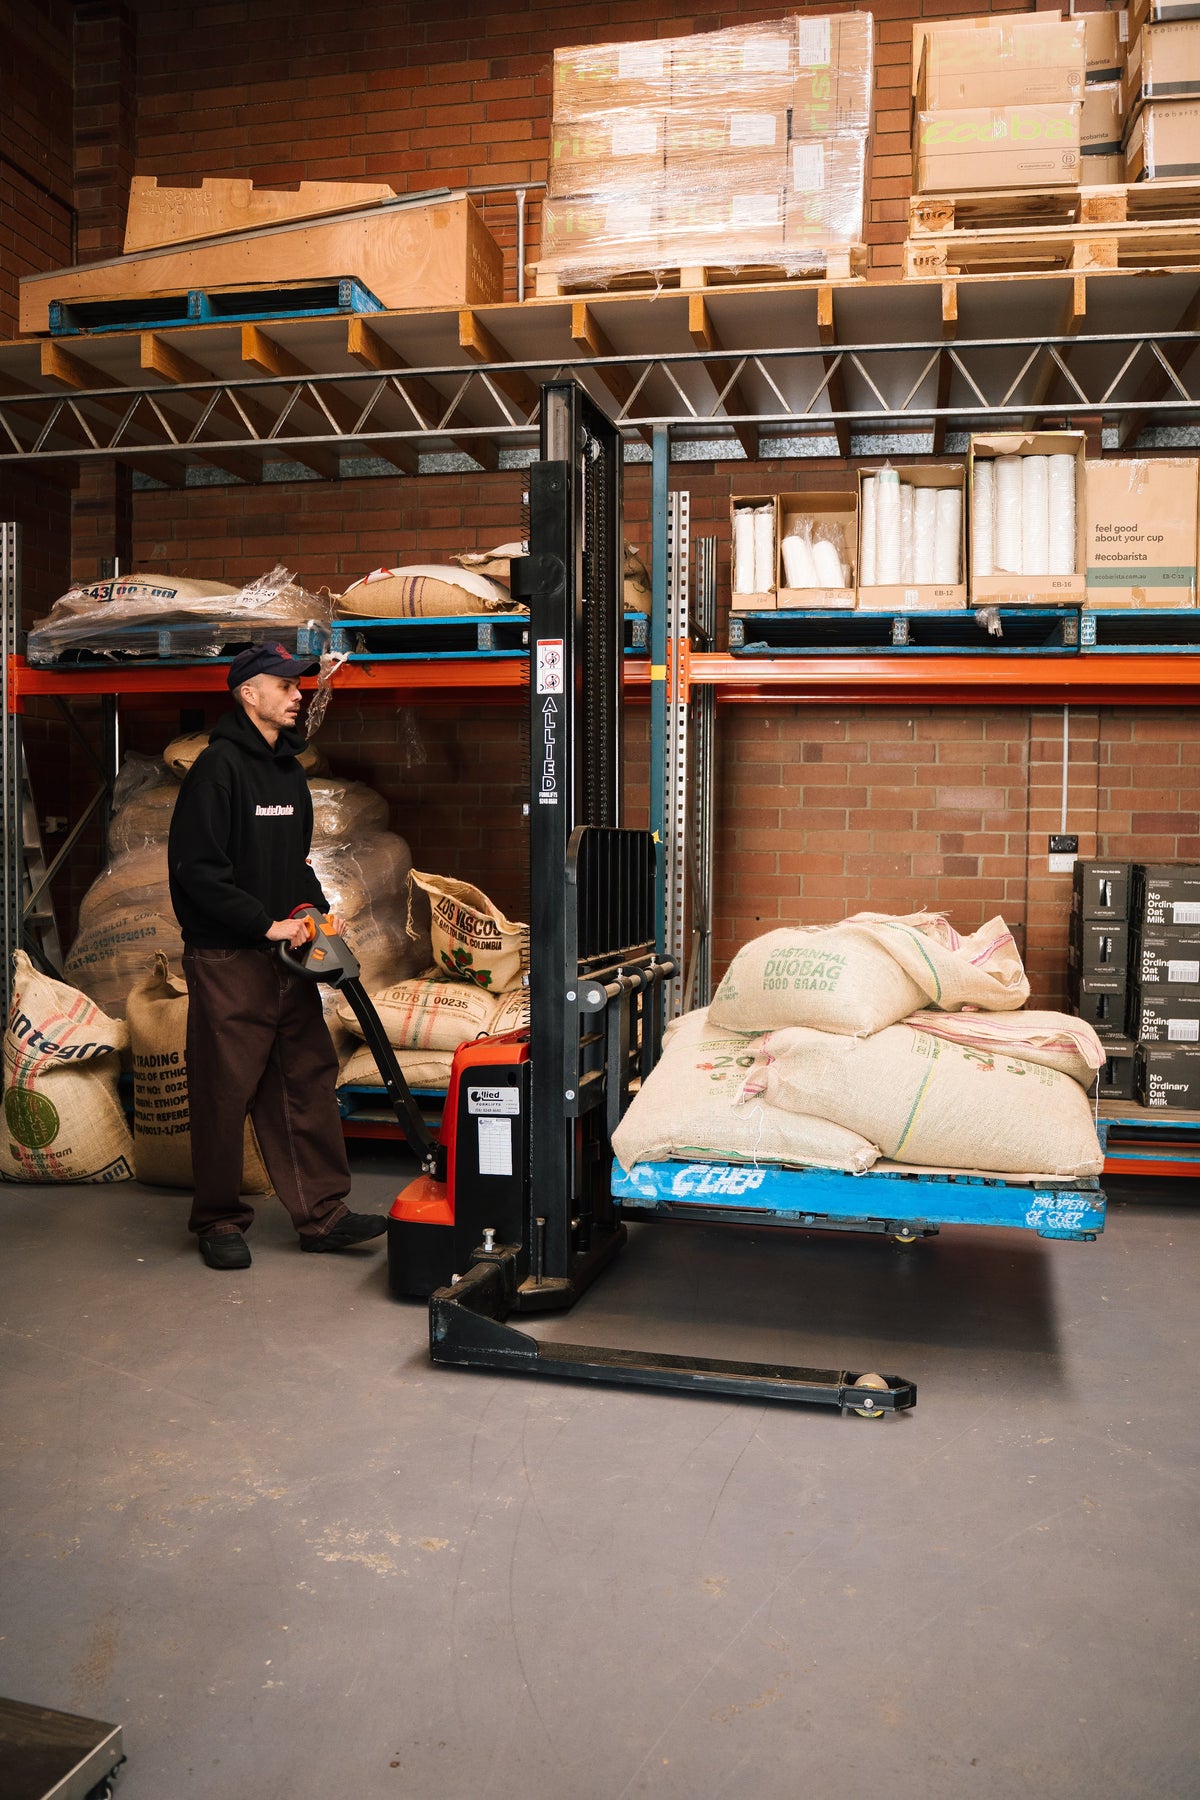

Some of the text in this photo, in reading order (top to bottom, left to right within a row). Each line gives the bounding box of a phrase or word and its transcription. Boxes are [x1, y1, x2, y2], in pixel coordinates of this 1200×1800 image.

[1147, 24, 1200, 35] ecobarist
[1095, 524, 1138, 534] feel good
[1095, 534, 1164, 543] about your cup
[1094, 552, 1148, 561] #ecobarista
[1094, 572, 1147, 580] ecobarista.com.au
[934, 589, 954, 597] EB-12
[541, 696, 558, 792] ALLIED
[1148, 892, 1161, 900] No
[1147, 900, 1174, 908] Ordin
[436, 896, 456, 921] LOS
[456, 908, 502, 937] VASCOS
[1147, 908, 1163, 916] Oat
[1147, 916, 1165, 924] Milk
[469, 938, 502, 951] COLOMBIA
[770, 948, 849, 966] CASTANHAL
[1143, 950, 1156, 958] No
[1142, 958, 1169, 967] Ordin
[763, 959, 844, 980] DUOBAG
[1142, 966, 1158, 974] Oat
[1142, 974, 1160, 982] Milk
[762, 977, 838, 992] FOOD GRADE
[391, 991, 421, 1003] 0178
[433, 996, 469, 1009] 00235
[1142, 1009, 1155, 1017] No
[1142, 1017, 1168, 1026] Ordin
[1142, 1025, 1158, 1033] Oat
[1141, 1033, 1160, 1041] Milk
[135, 1052, 179, 1068] TRADING
[1149, 1074, 1163, 1082] No
[1149, 1082, 1189, 1092] Ordinary
[1149, 1090, 1166, 1098] Oat
[1149, 1098, 1168, 1106] Milk
[156, 1108, 190, 1122] REFERE
[24, 1147, 73, 1163] upstream
